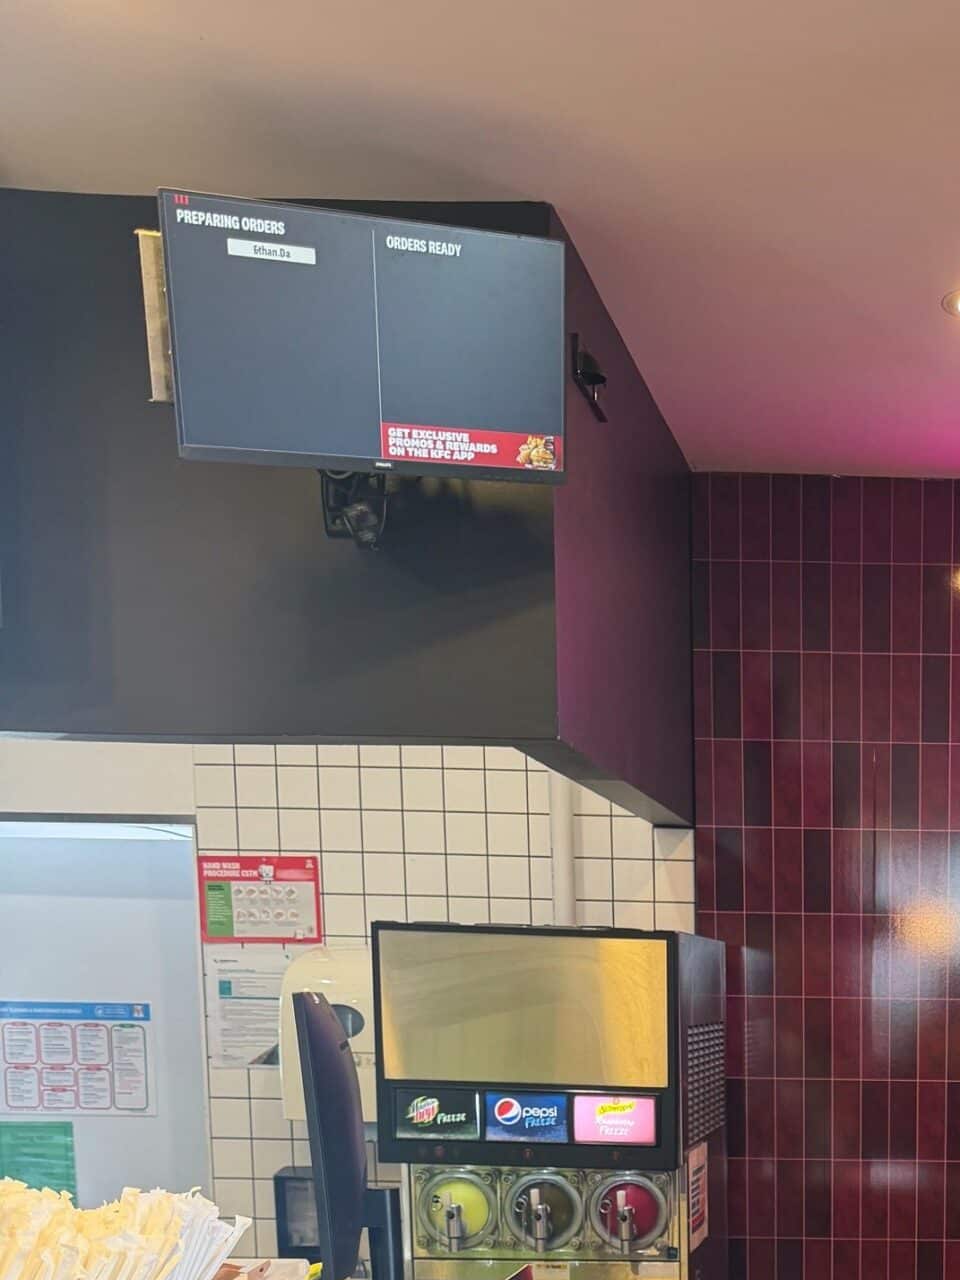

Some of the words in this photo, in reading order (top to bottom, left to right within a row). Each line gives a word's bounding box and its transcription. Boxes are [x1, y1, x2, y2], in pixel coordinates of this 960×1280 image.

[176, 208, 240, 230] PREPARING
[241, 217, 286, 236] ORDERS
[386, 235, 427, 253] ORDERS
[428, 240, 462, 257] READY
[388, 427, 410, 438] GET
[411, 429, 470, 442] EXCLUSIVE
[388, 437, 433, 449] PROMOS
[435, 440, 444, 449] &
[445, 442, 498, 454] REWARDS
[388, 446, 405, 456] ON
[406, 447, 429, 458] THE
[430, 449, 452, 459] KFC
[452, 451, 475, 461] APP
[522, 1106, 558, 1118] pepsi
